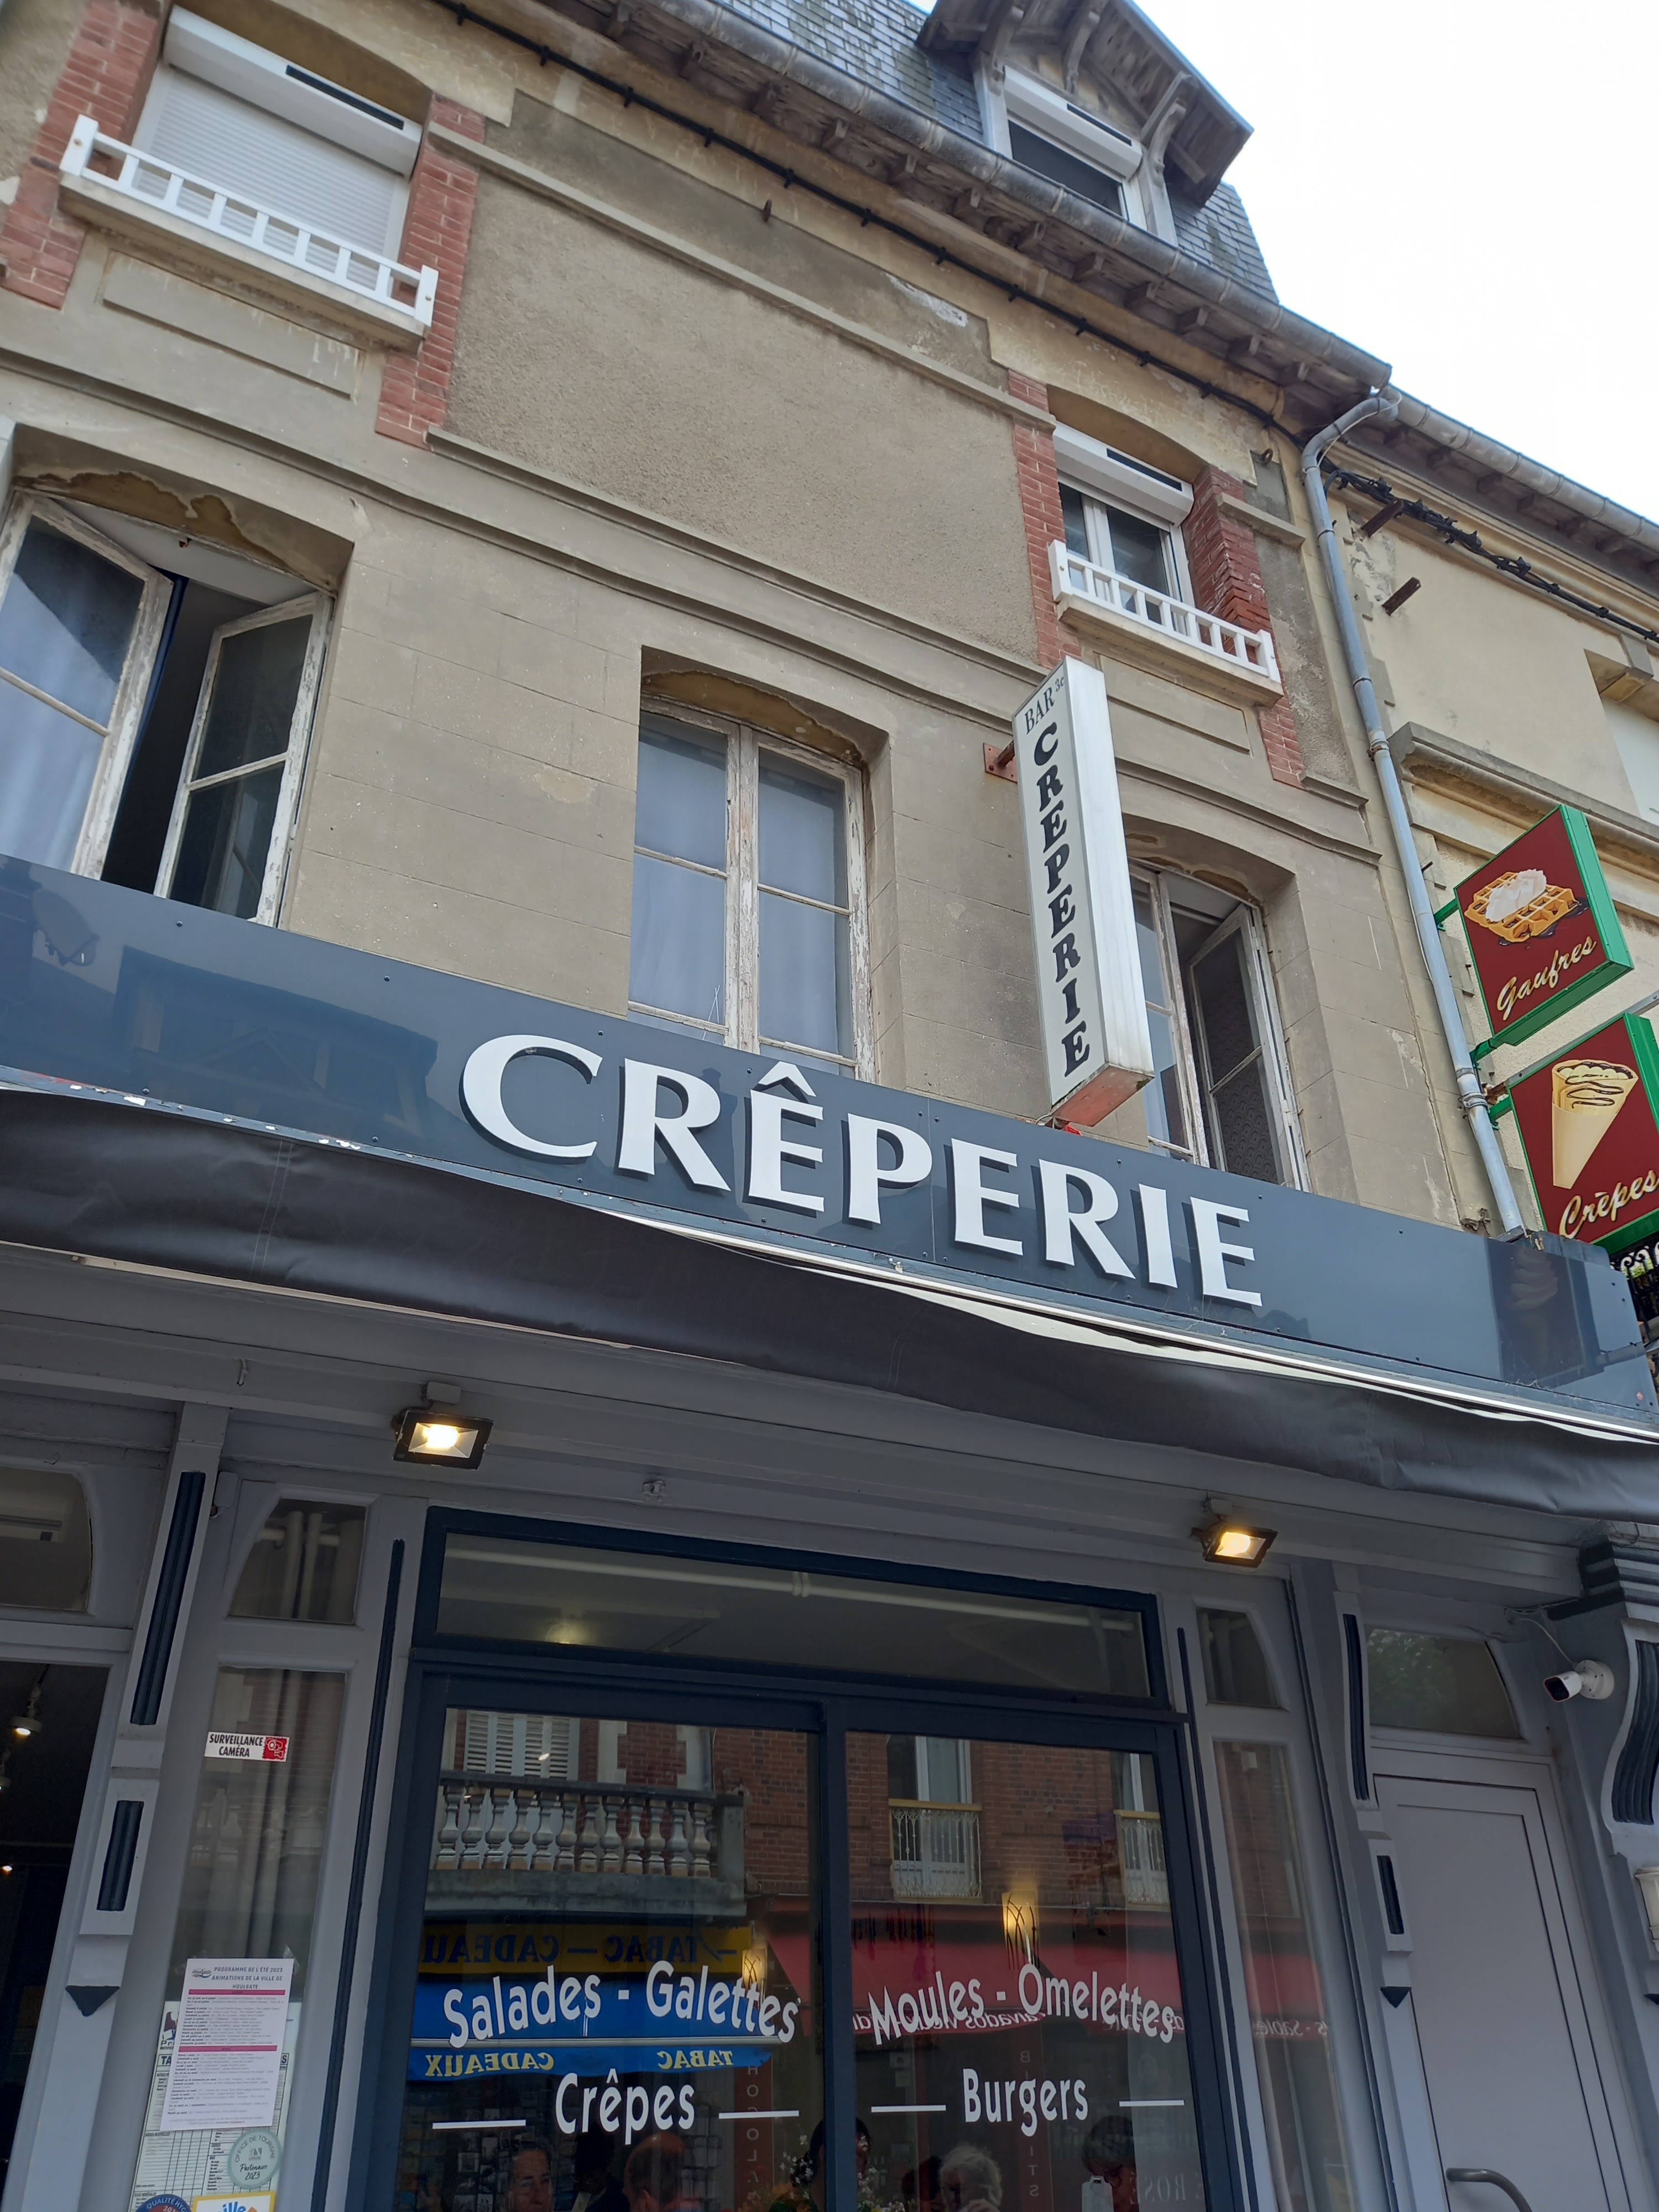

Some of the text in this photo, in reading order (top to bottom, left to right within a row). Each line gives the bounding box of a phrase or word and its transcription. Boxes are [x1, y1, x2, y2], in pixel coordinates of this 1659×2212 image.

[1024, 687, 1055, 735] BAR
[1034, 721, 1090, 1078] CREPERIE
[1497, 936, 1597, 1021] Gaufres
[461, 1034, 1264, 1307] CRÊPERIE
[1559, 1170, 1659, 1239] Crêpes
[209, 1734, 264, 1746] SURVEILLANCE
[219, 1744, 250, 1757] CAMÉRA
[443, 1965, 601, 2048] Salades
[646, 1960, 798, 2043] Galettes
[867, 1970, 984, 2046] Moules
[1019, 1964, 1175, 2044] Omelettes
[555, 2068, 696, 2145] Crêpes
[963, 2068, 1089, 2137] Burgers
[234, 2140, 249, 2163] OFFICE
[258, 2135, 275, 2159] TOURISME
[239, 2163, 268, 2172] Partenaire
[244, 2171, 260, 2180] 2023
[147, 2197, 176, 2209] QUALITÉ
